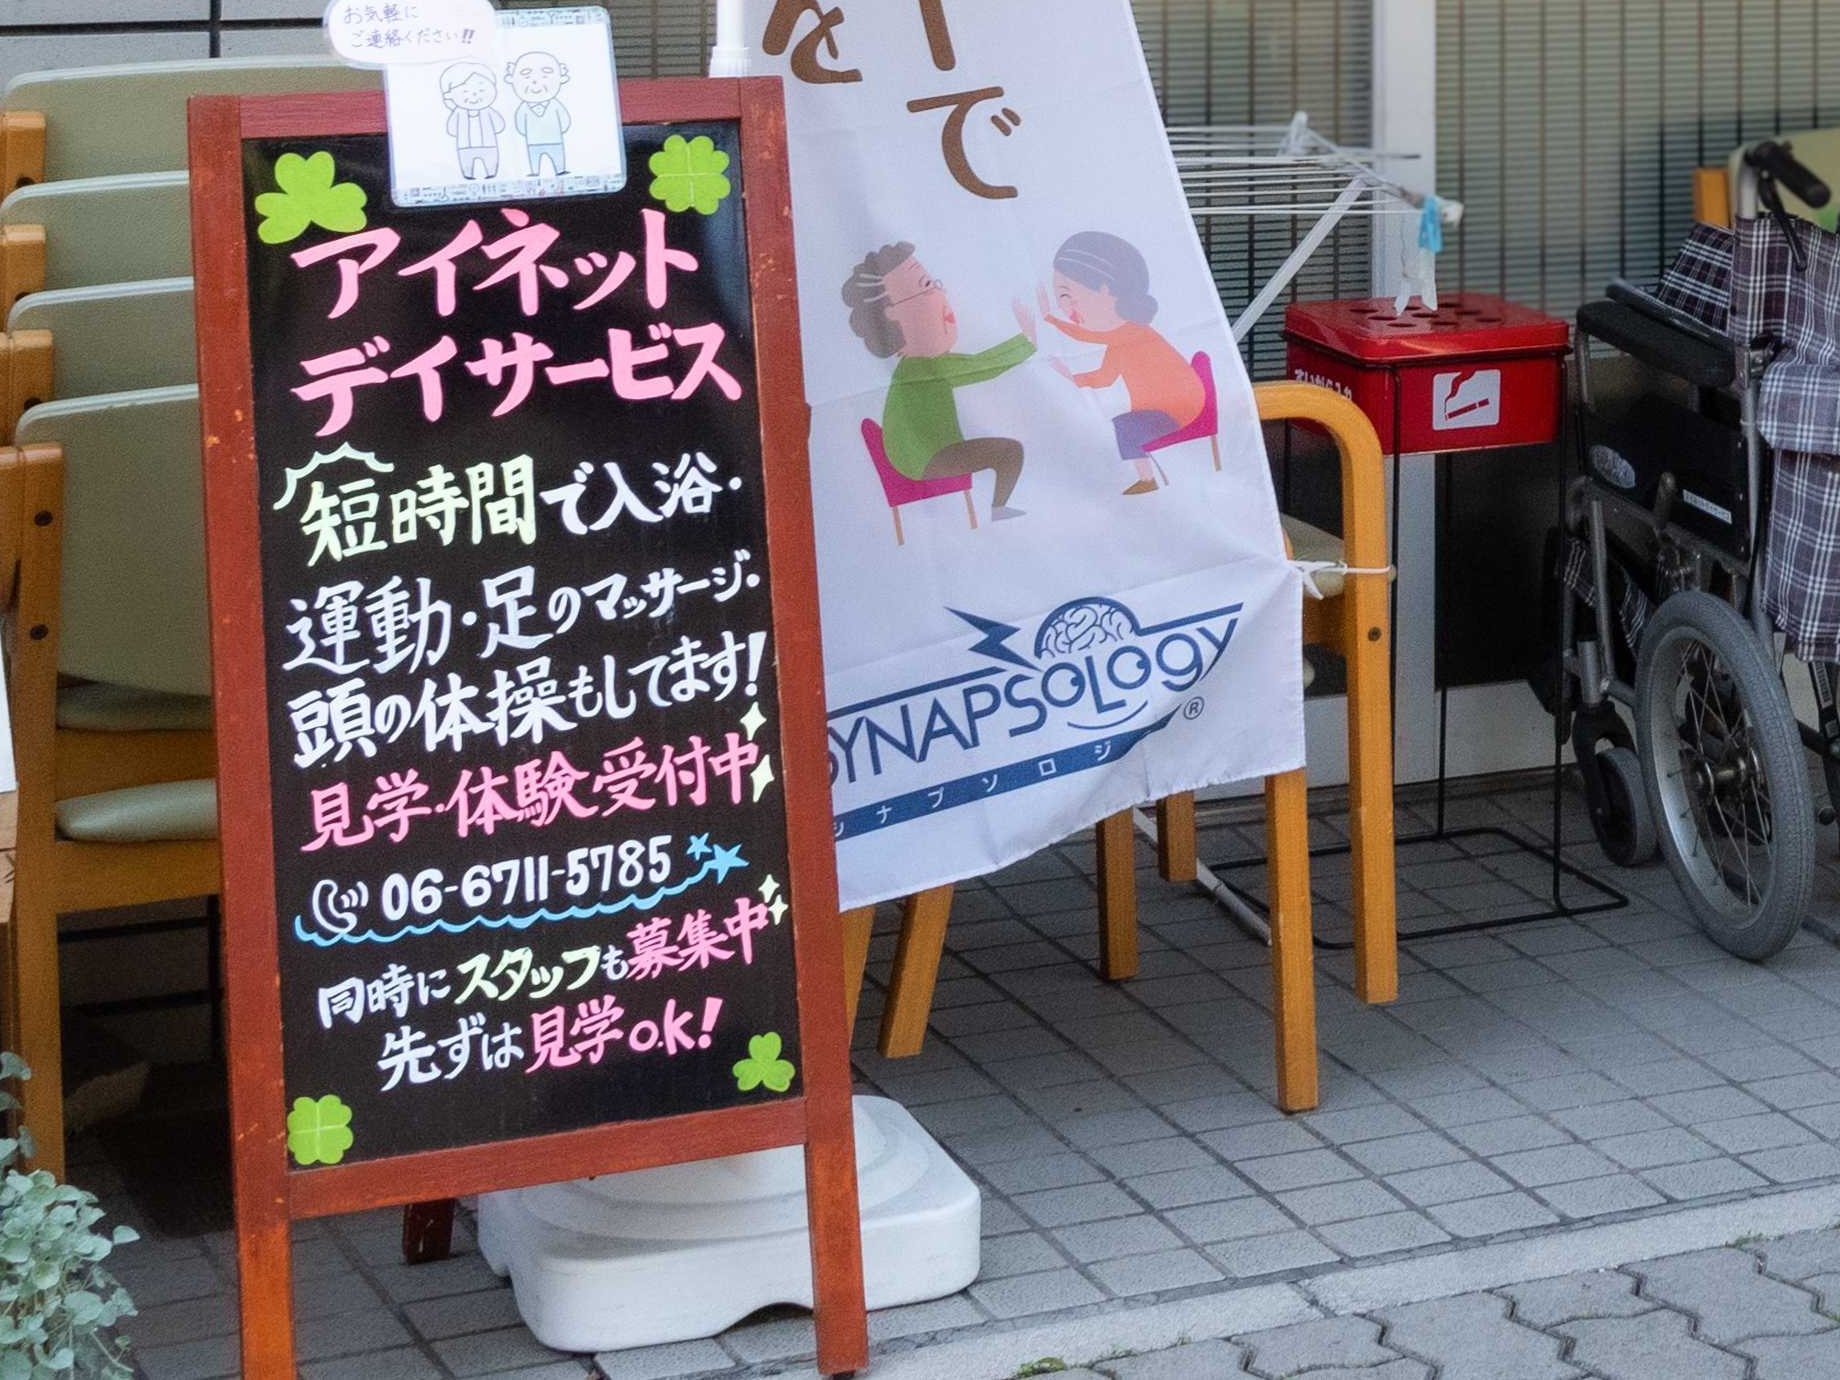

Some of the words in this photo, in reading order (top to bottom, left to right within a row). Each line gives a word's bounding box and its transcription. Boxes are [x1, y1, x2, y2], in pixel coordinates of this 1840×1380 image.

[343, 3, 419, 24] お気軽に
[291, 208, 699, 320] アイネット
[291, 322, 742, 437] デイサービス
[381, 835, 672, 922] 06-6711-5785
[318, 897, 770, 1029] 同時にスタッフも募集中
